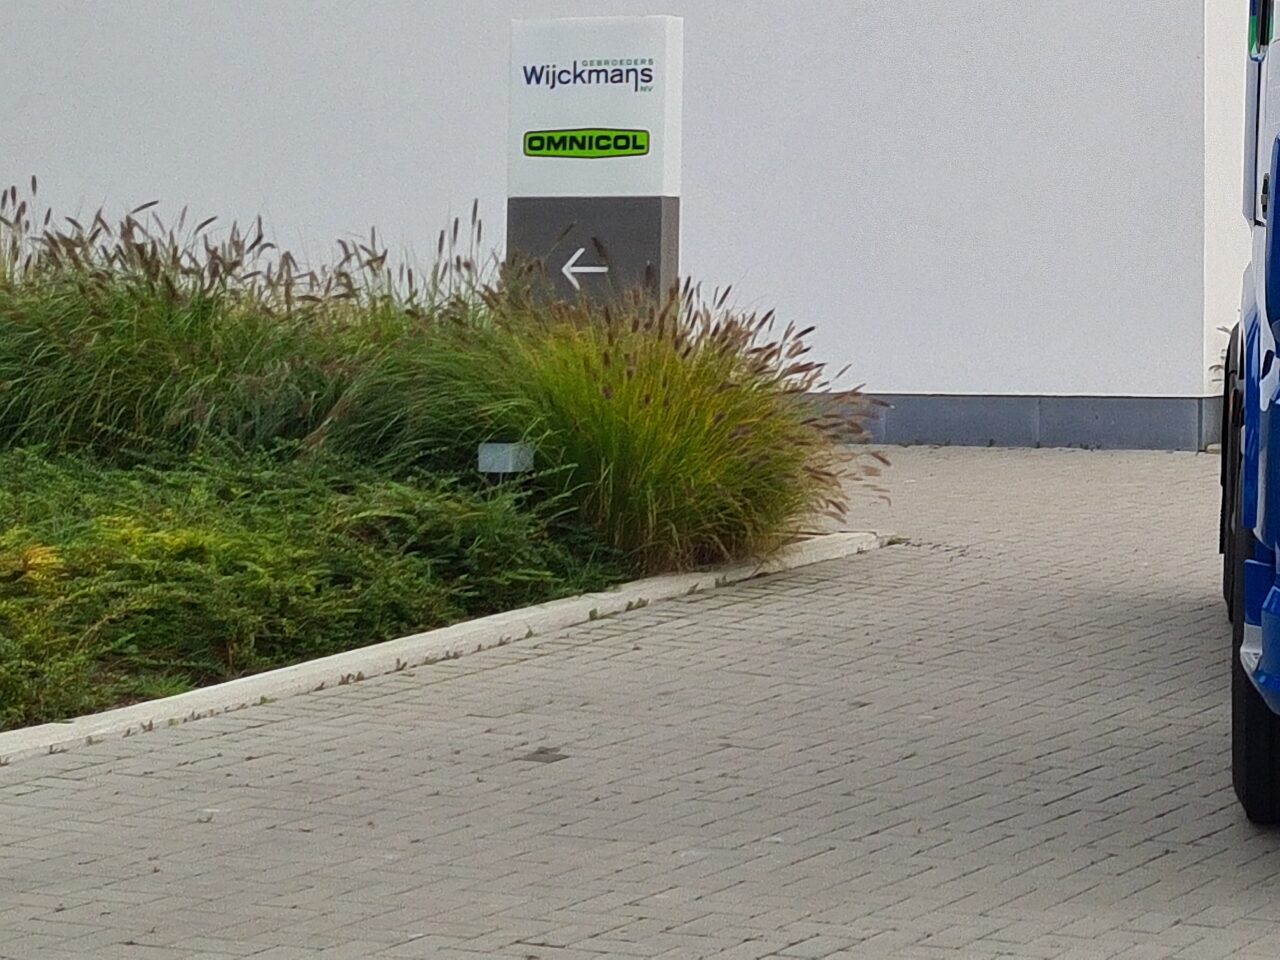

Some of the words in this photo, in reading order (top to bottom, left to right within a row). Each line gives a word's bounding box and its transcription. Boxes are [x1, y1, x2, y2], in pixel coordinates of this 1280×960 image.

[582, 58, 654, 67] GEBROEDERS
[523, 60, 653, 92] Wijckmans
[527, 134, 645, 152] OMNICOL
